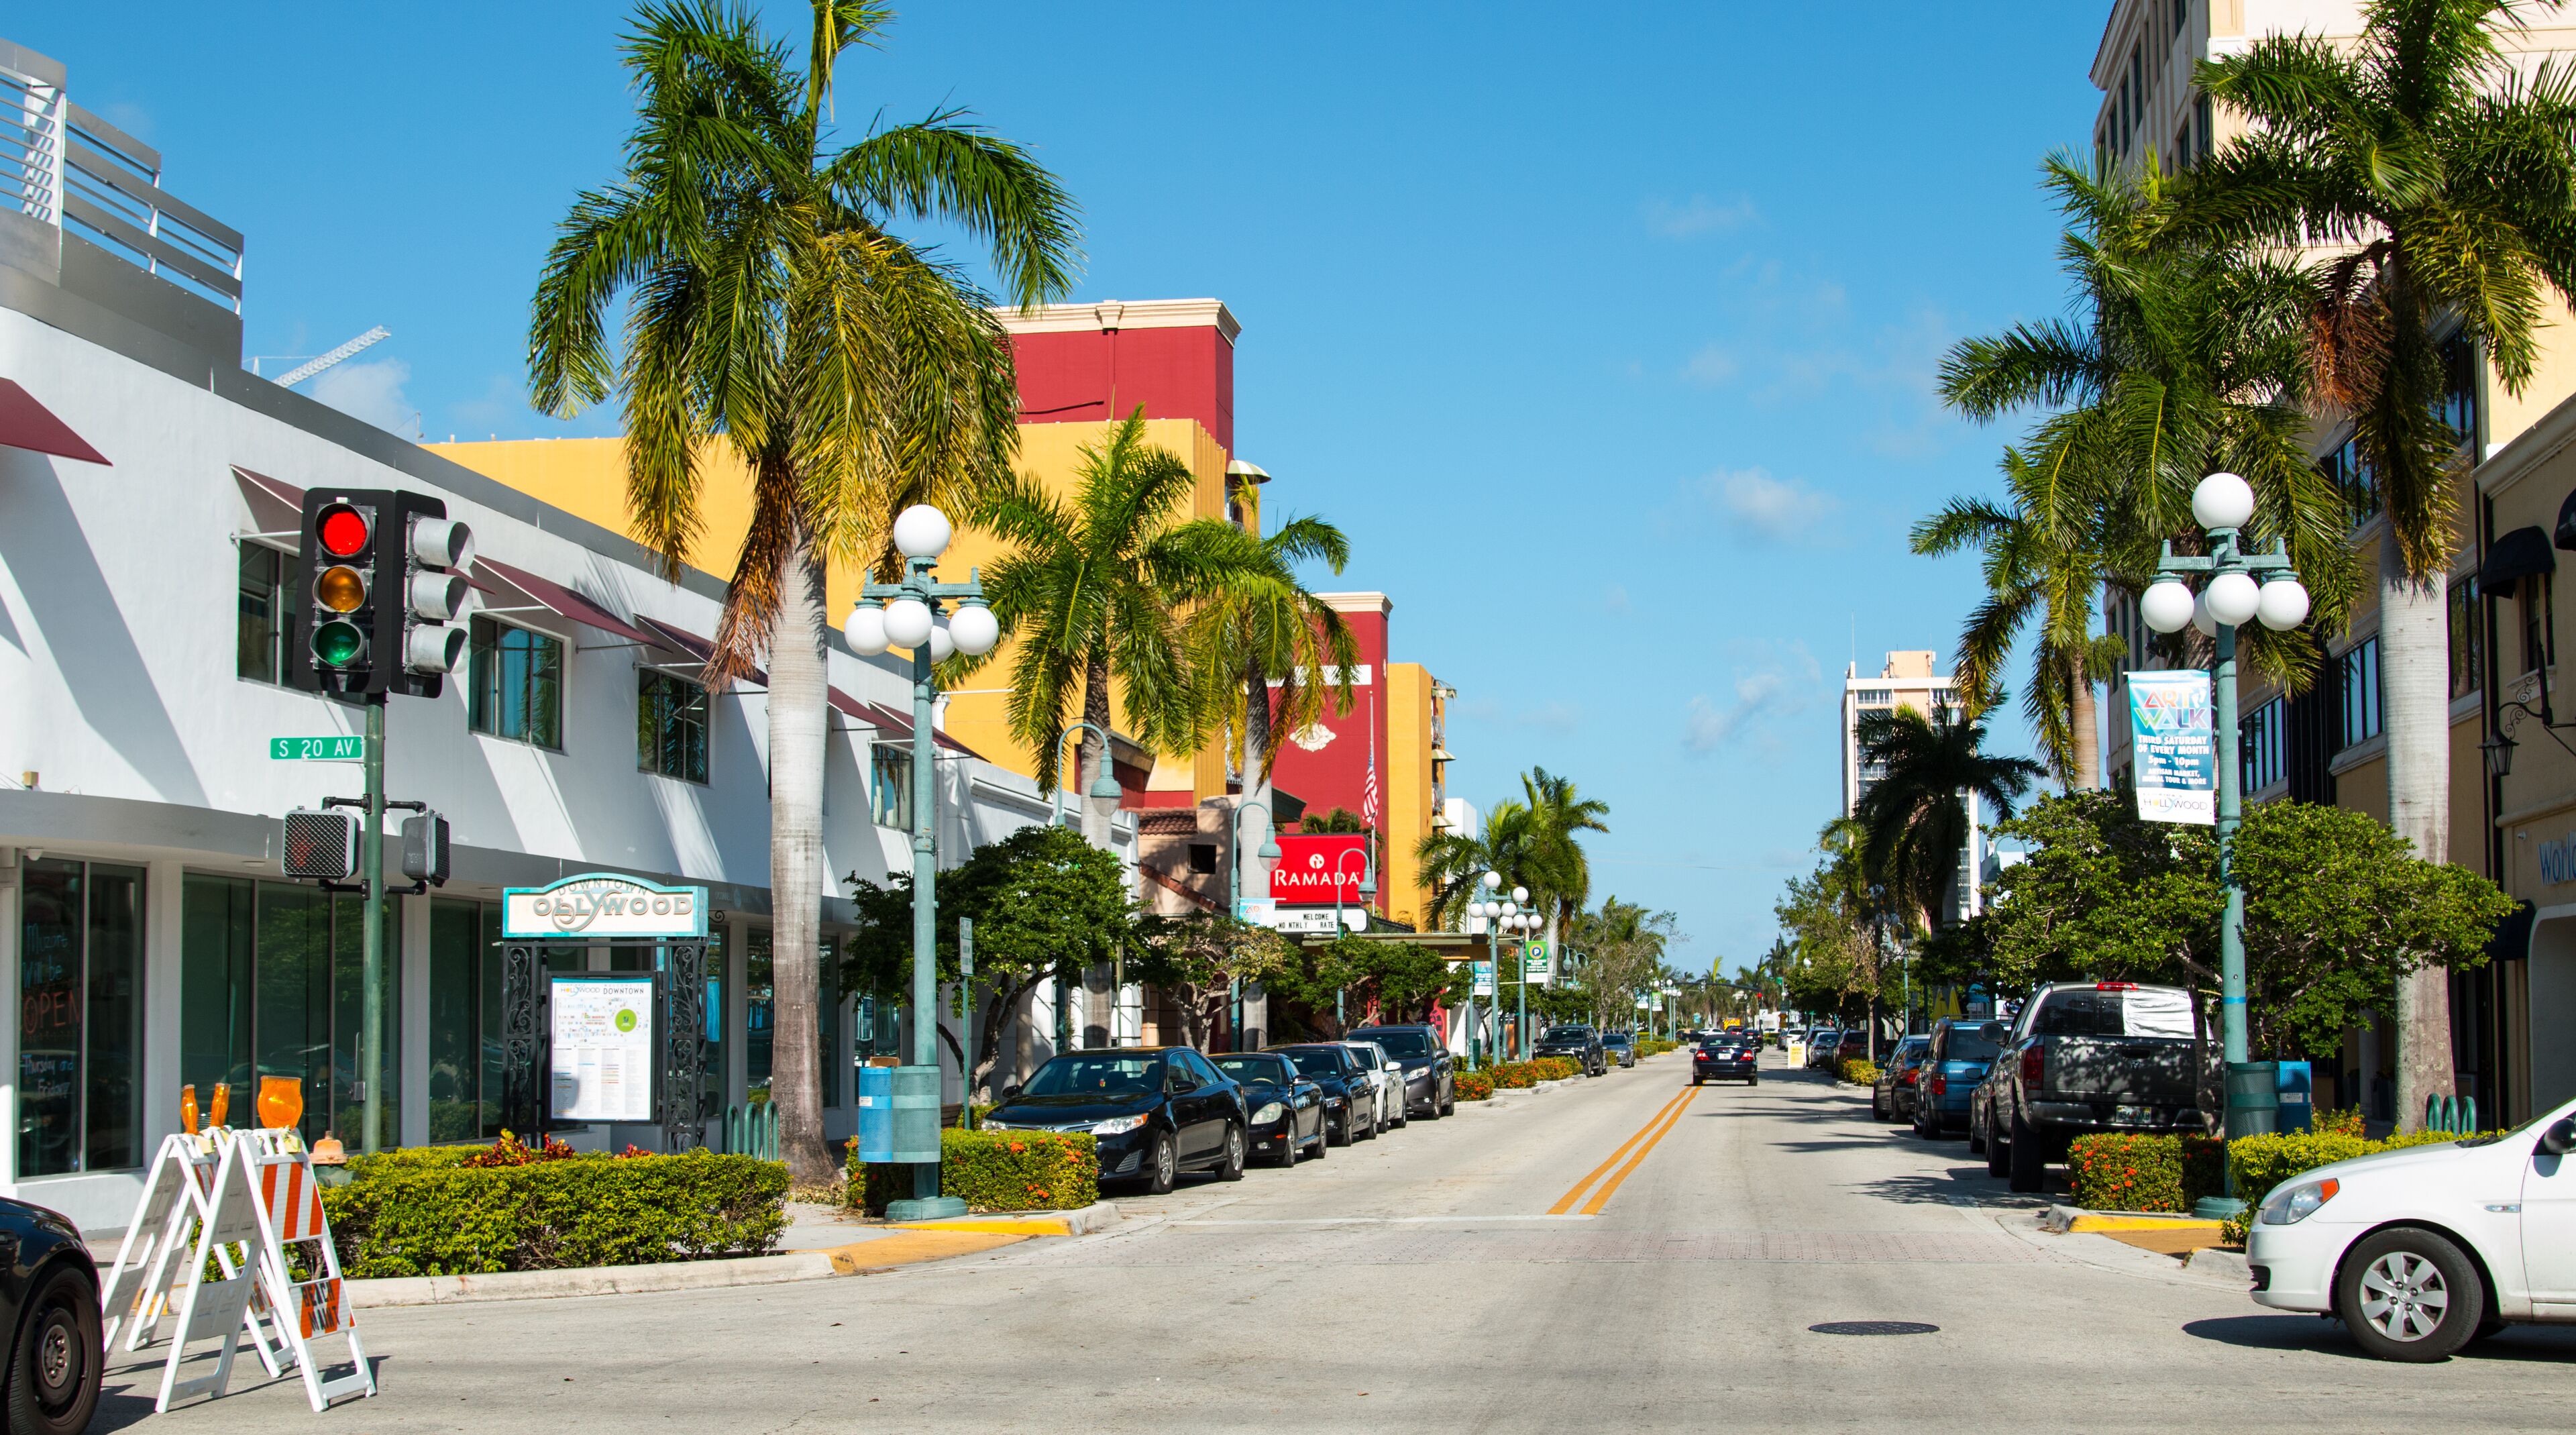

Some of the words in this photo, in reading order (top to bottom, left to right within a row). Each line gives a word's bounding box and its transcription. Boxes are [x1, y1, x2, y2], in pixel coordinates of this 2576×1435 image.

[2143, 690, 2193, 708] ART
[2134, 708, 2208, 729] WALK
[278, 740, 288, 757] S
[301, 739, 323, 757] 20
[333, 739, 354, 756] AV
[2137, 735, 2161, 744] THIRD
[2163, 736, 2208, 745] SATURDAY
[2137, 745, 2147, 753] OF
[2151, 745, 2175, 754] EVERY
[2178, 745, 2209, 755] MONTH
[2148, 755, 2166, 765] 5pm
[2175, 757, 2199, 767] 10pm
[2174, 769, 2200, 778] MARKET,
[557, 878, 648, 896] DOWNTOWN
[1275, 869, 1360, 887] RAMADA
[23, 988, 80, 1034] OPEN
[301, 1280, 335, 1308] BEACH
